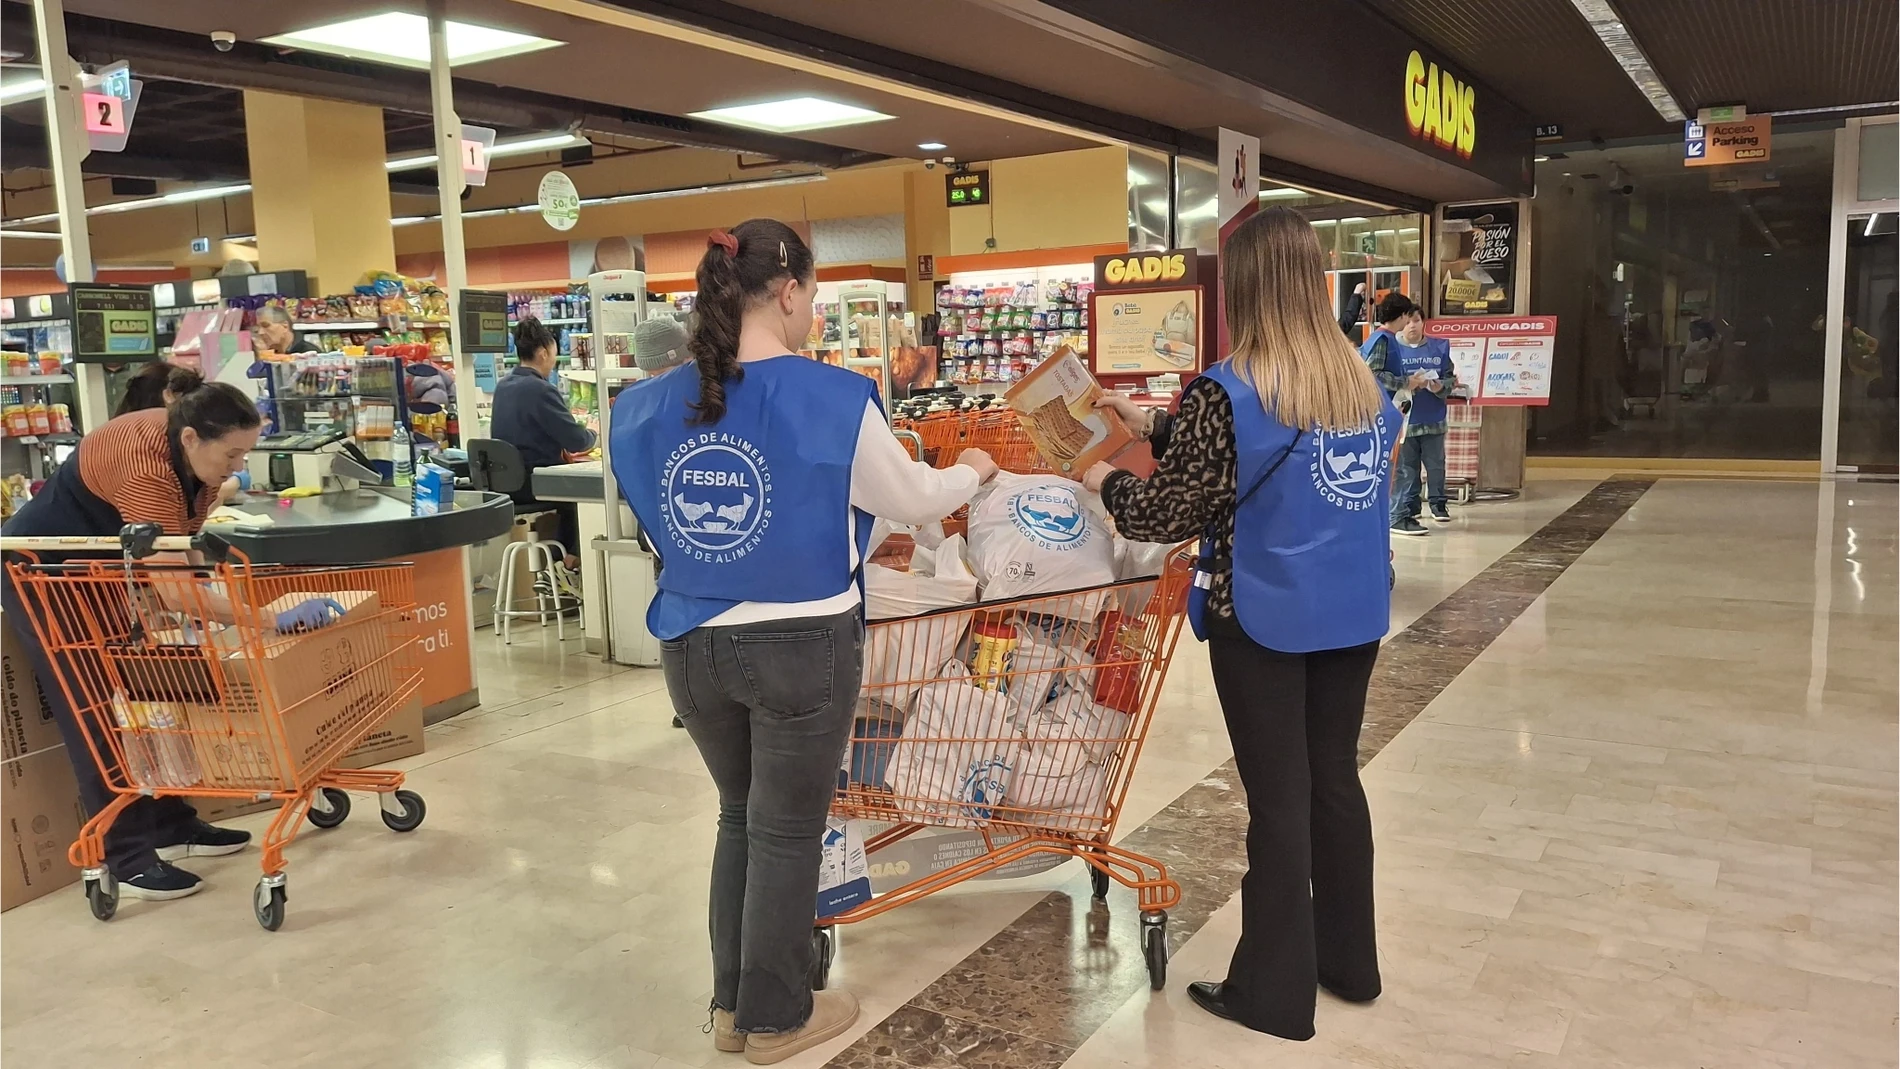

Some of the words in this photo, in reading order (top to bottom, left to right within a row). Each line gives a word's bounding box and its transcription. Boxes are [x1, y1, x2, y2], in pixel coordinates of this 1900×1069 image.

[1405, 50, 1475, 158] GADIS
[98, 102, 112, 126] 2
[1547, 125, 1558, 135] 13
[1713, 126, 1755, 135] Acceso
[1712, 136, 1759, 147] Parking
[470, 146, 475, 165] 1
[953, 175, 979, 186] GADIS
[1472, 225, 1511, 243] PASIÓN
[1474, 241, 1493, 250] POR
[1494, 239, 1506, 247] EL
[1471, 246, 1509, 263] QUESO
[1105, 254, 1186, 284] GADIS
[1465, 301, 1488, 309] GADIS
[111, 321, 147, 332] GADIS
[1432, 322, 1545, 333] OPORTUNIGADIS
[1052, 369, 1074, 398] TOSTADAS
[661, 438, 697, 487] BANCOS
[700, 432, 717, 444] DE
[720, 432, 772, 492] ALIMENTOS
[682, 470, 749, 488] FESBAL
[1311, 462, 1344, 507] BANCOS
[1346, 500, 1360, 511] DE
[1028, 494, 1075, 509] FESBAL
[660, 504, 692, 555] BANCOS
[694, 550, 712, 563] DE
[715, 509, 772, 564] ALIMENTOS
[1008, 512, 1036, 543] BANCOS
[1038, 540, 1051, 551] DE
